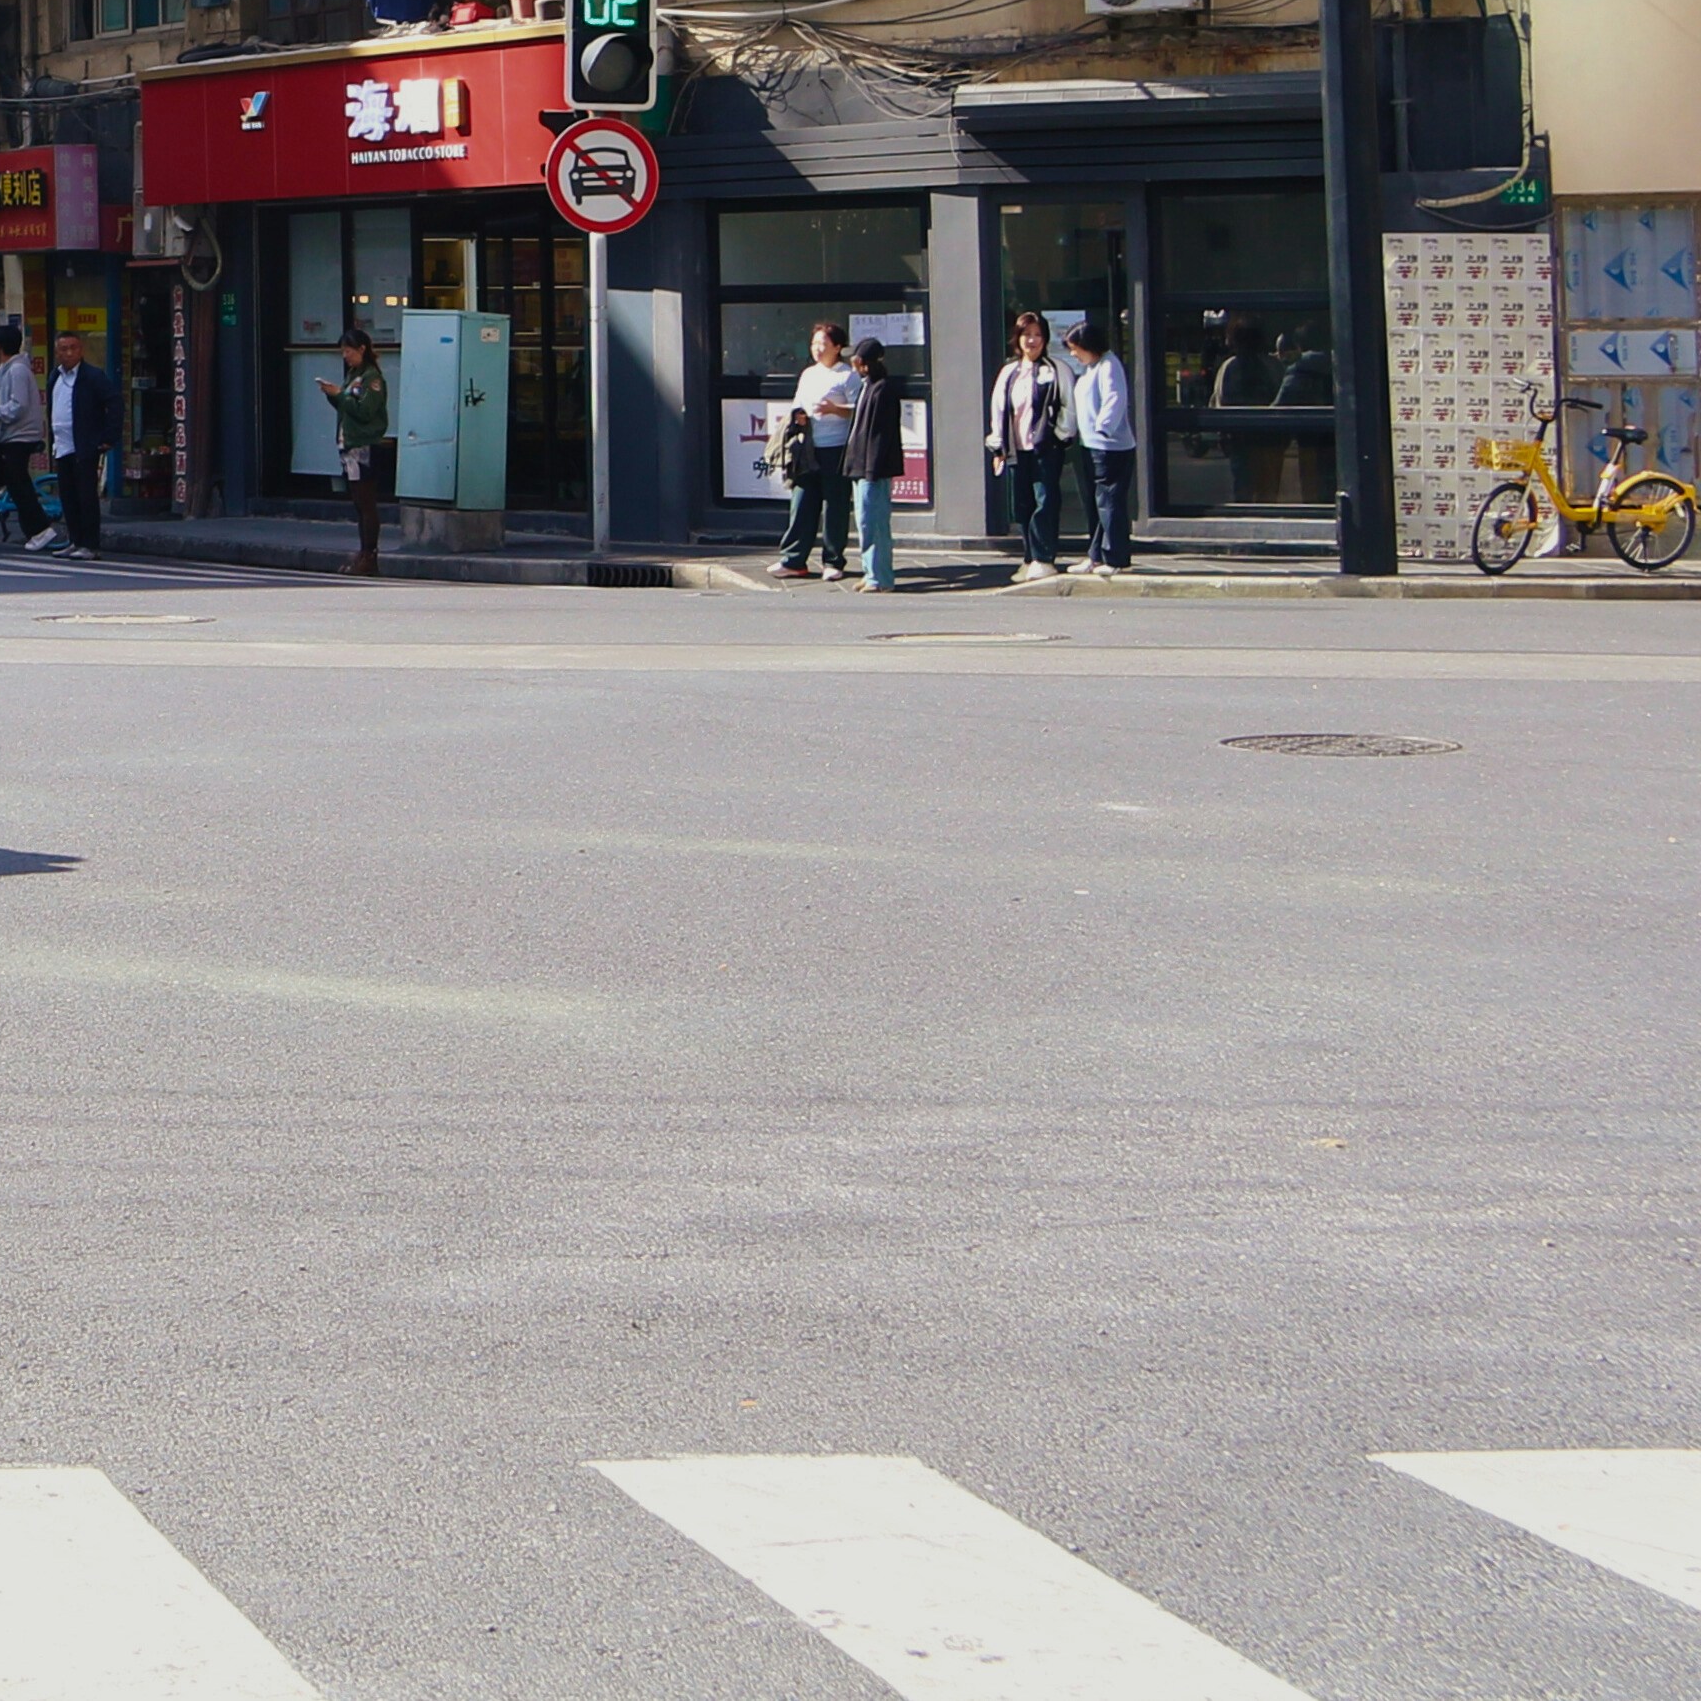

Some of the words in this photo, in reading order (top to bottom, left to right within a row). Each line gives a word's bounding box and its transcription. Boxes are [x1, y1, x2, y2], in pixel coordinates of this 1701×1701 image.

[351, 150, 387, 165] HAIYAN
[388, 147, 433, 162] TOBACCO
[434, 144, 465, 159] STORE
